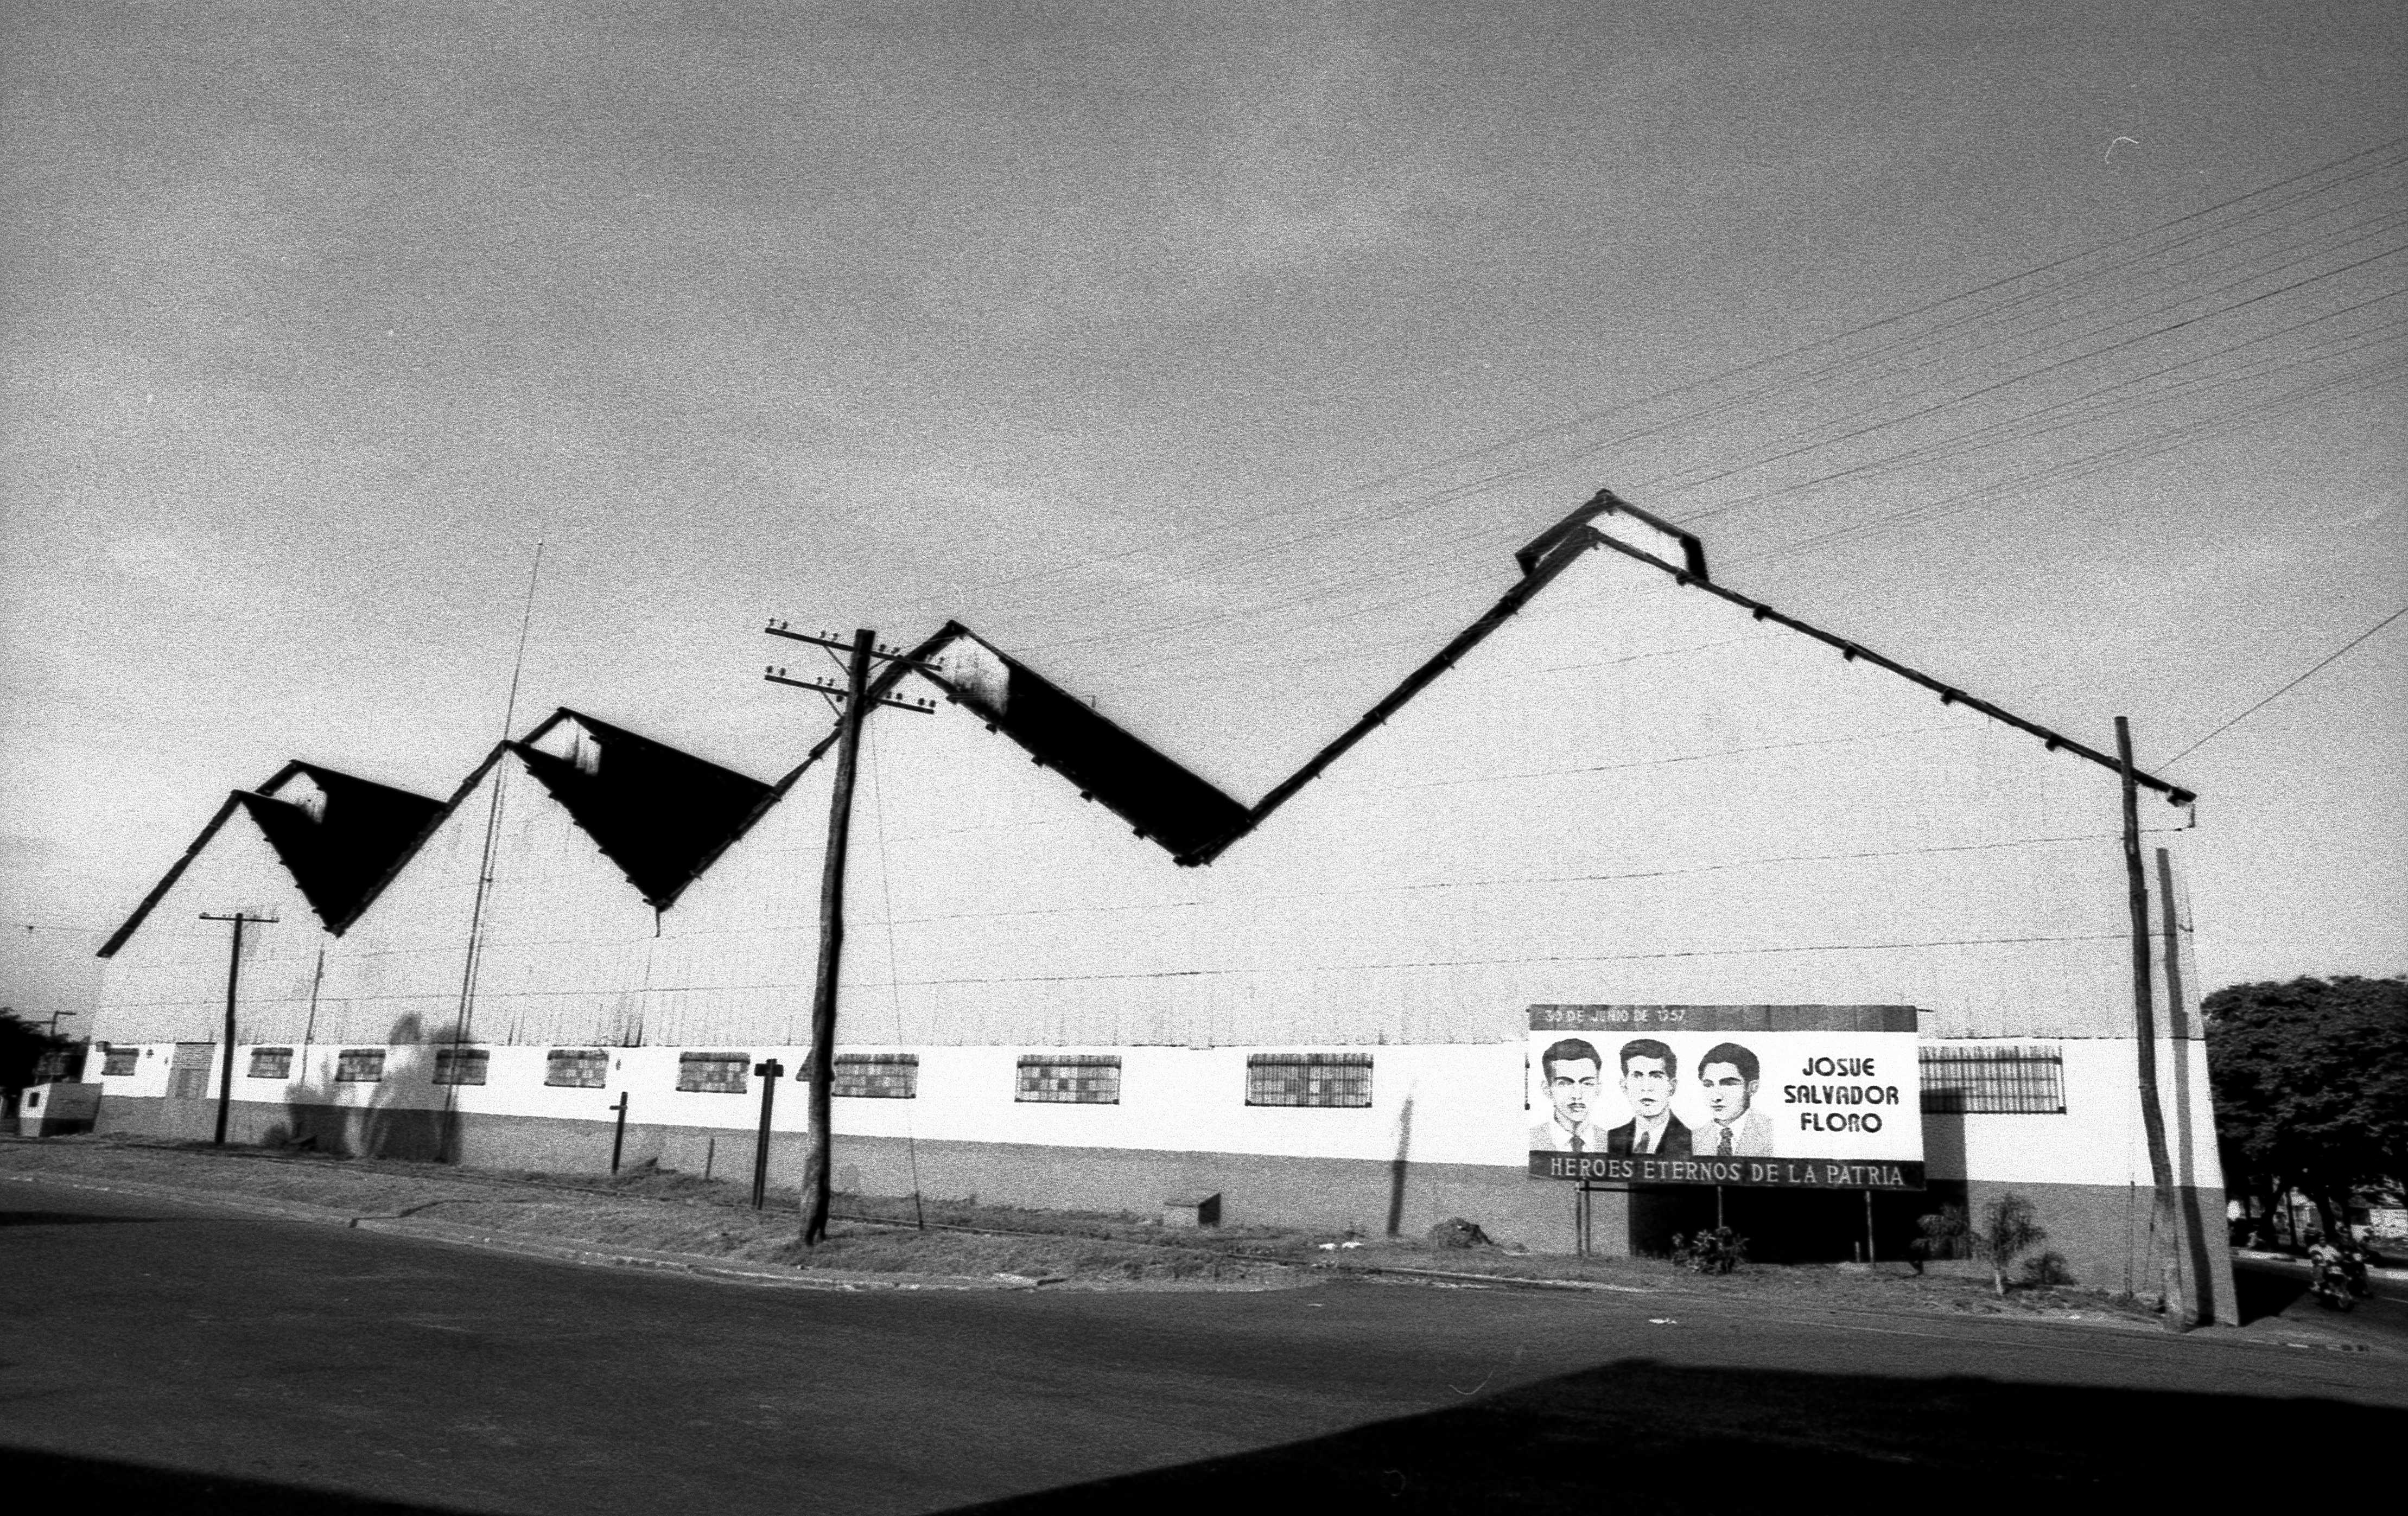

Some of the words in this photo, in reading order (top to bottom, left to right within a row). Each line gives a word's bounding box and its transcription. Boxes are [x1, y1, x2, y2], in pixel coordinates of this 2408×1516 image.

[1567, 1010, 1584, 1022] DE
[1634, 1009, 1648, 1022] DE
[1802, 1056, 1875, 1077] JOSUE
[1783, 1085, 1899, 1105] SALVADOR
[1801, 1112, 1882, 1133] FLORO
[1551, 1158, 1634, 1178] HEROES
[1644, 1160, 1741, 1181] ETERNOS
[1750, 1163, 1778, 1182] DE
[1789, 1164, 1817, 1183] LA
[1826, 1164, 1905, 1186] PATRIA
